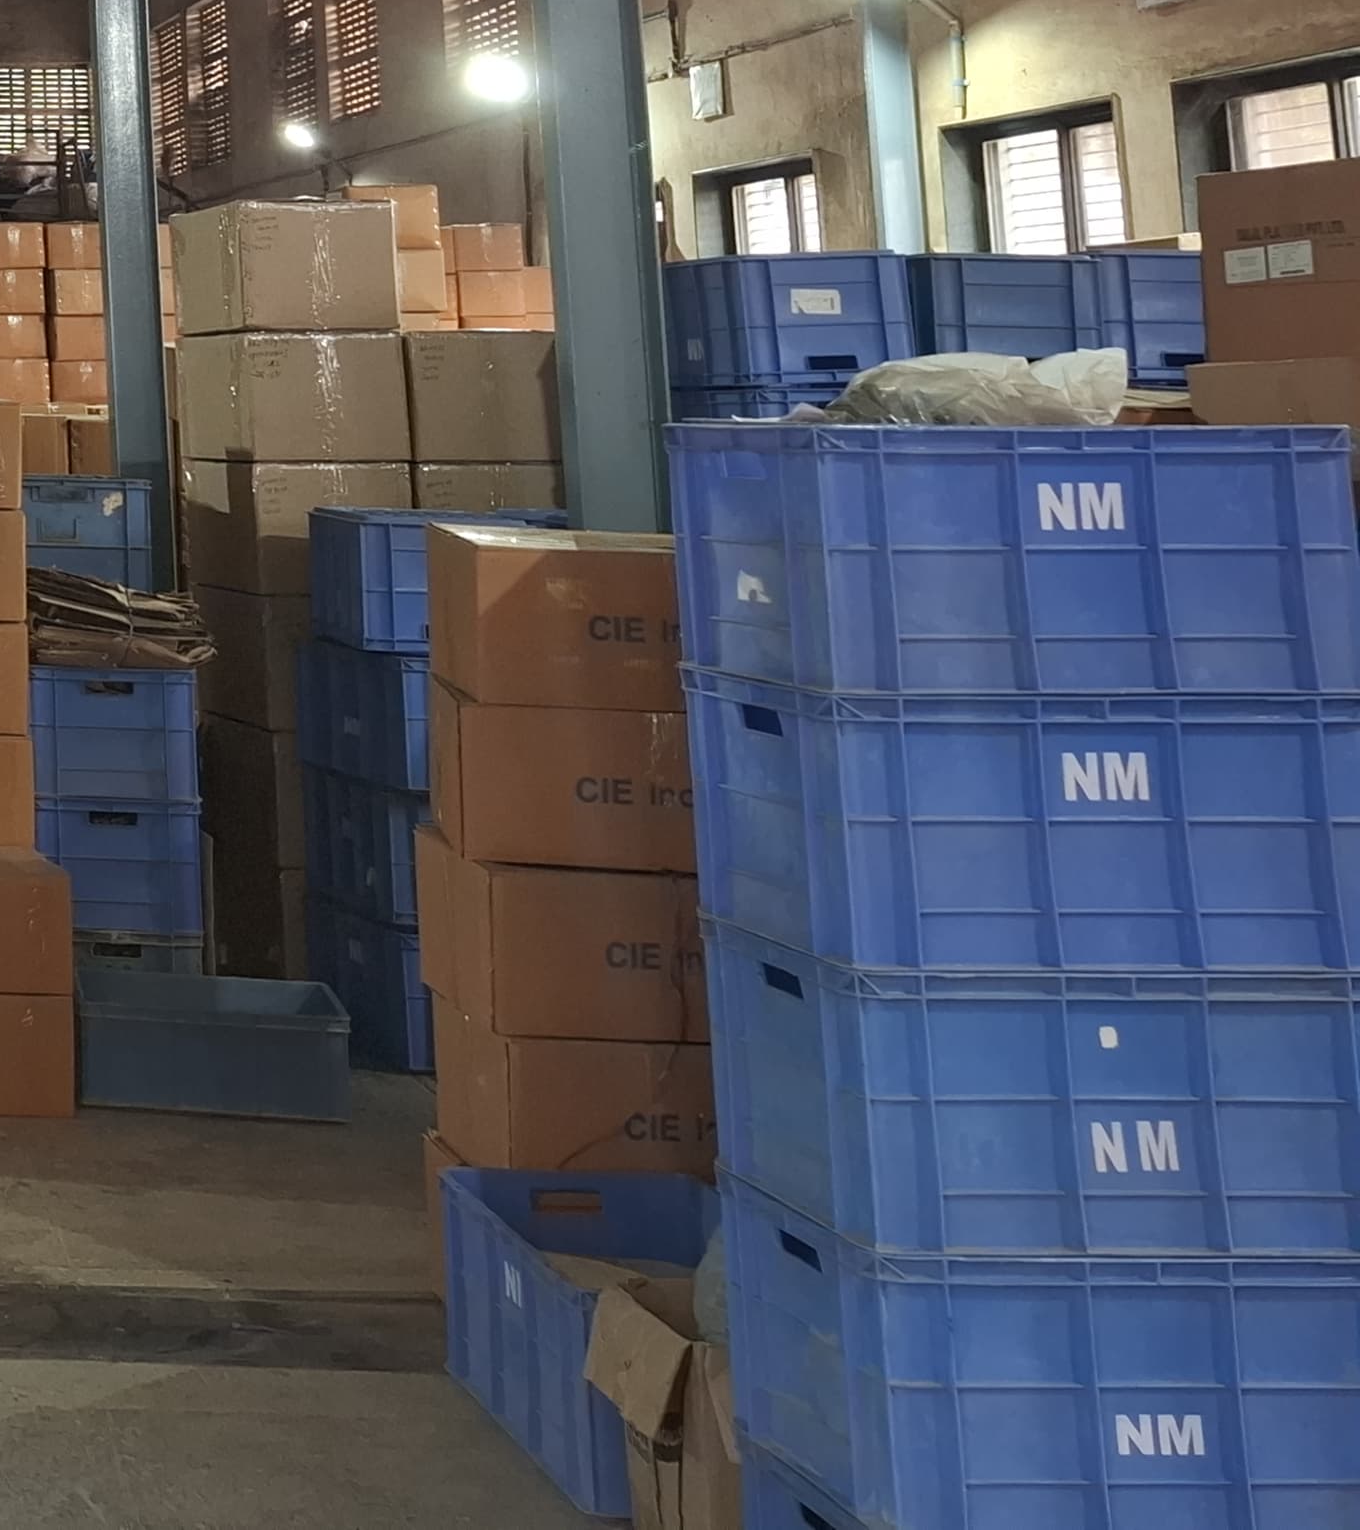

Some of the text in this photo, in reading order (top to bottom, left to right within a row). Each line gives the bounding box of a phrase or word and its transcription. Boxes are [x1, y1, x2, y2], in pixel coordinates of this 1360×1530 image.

[1037, 482, 1125, 532] NM
[588, 615, 646, 643] CIE
[575, 776, 634, 805] CIE
[1063, 752, 1151, 802] NM
[605, 941, 662, 970] CIE
[623, 1112, 681, 1142] CIE
[1115, 1413, 1206, 1458] NM
